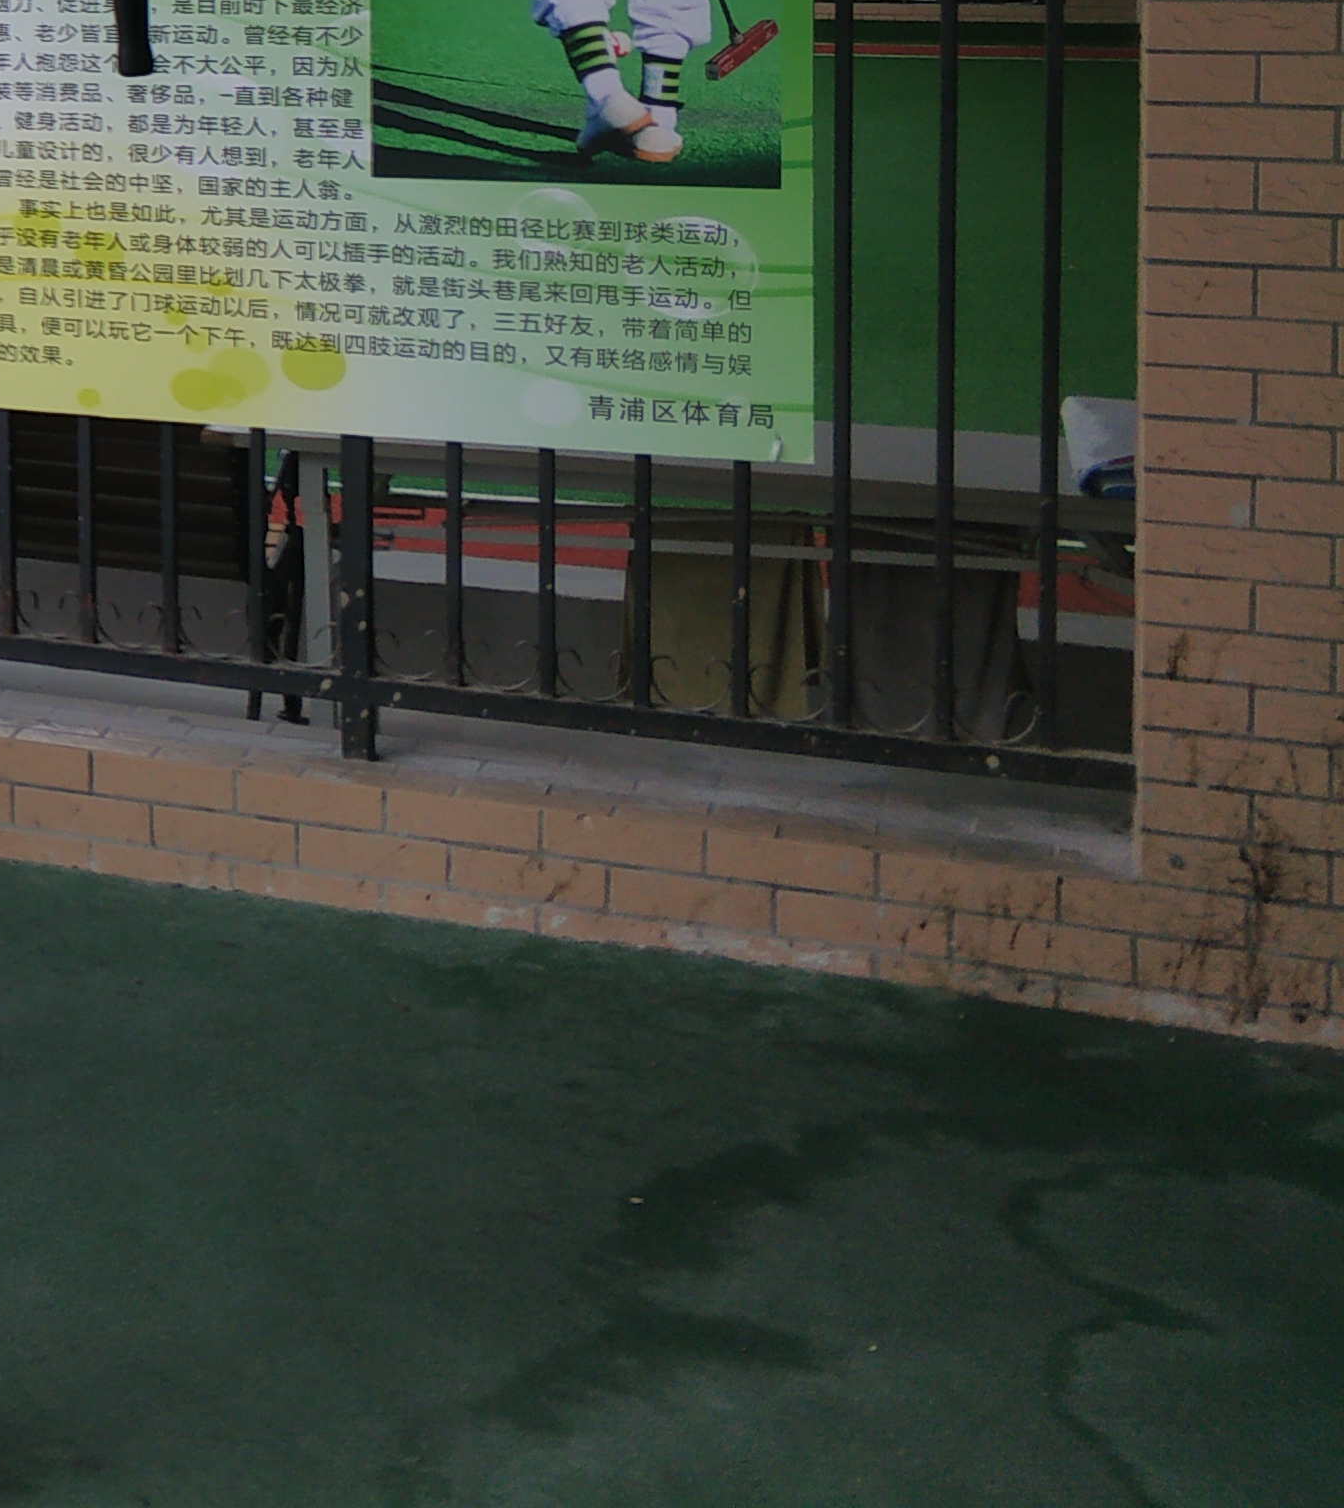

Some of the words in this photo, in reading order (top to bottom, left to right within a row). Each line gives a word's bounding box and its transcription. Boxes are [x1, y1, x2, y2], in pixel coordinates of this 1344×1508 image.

[588, 394, 775, 430] 青浦区体育局
